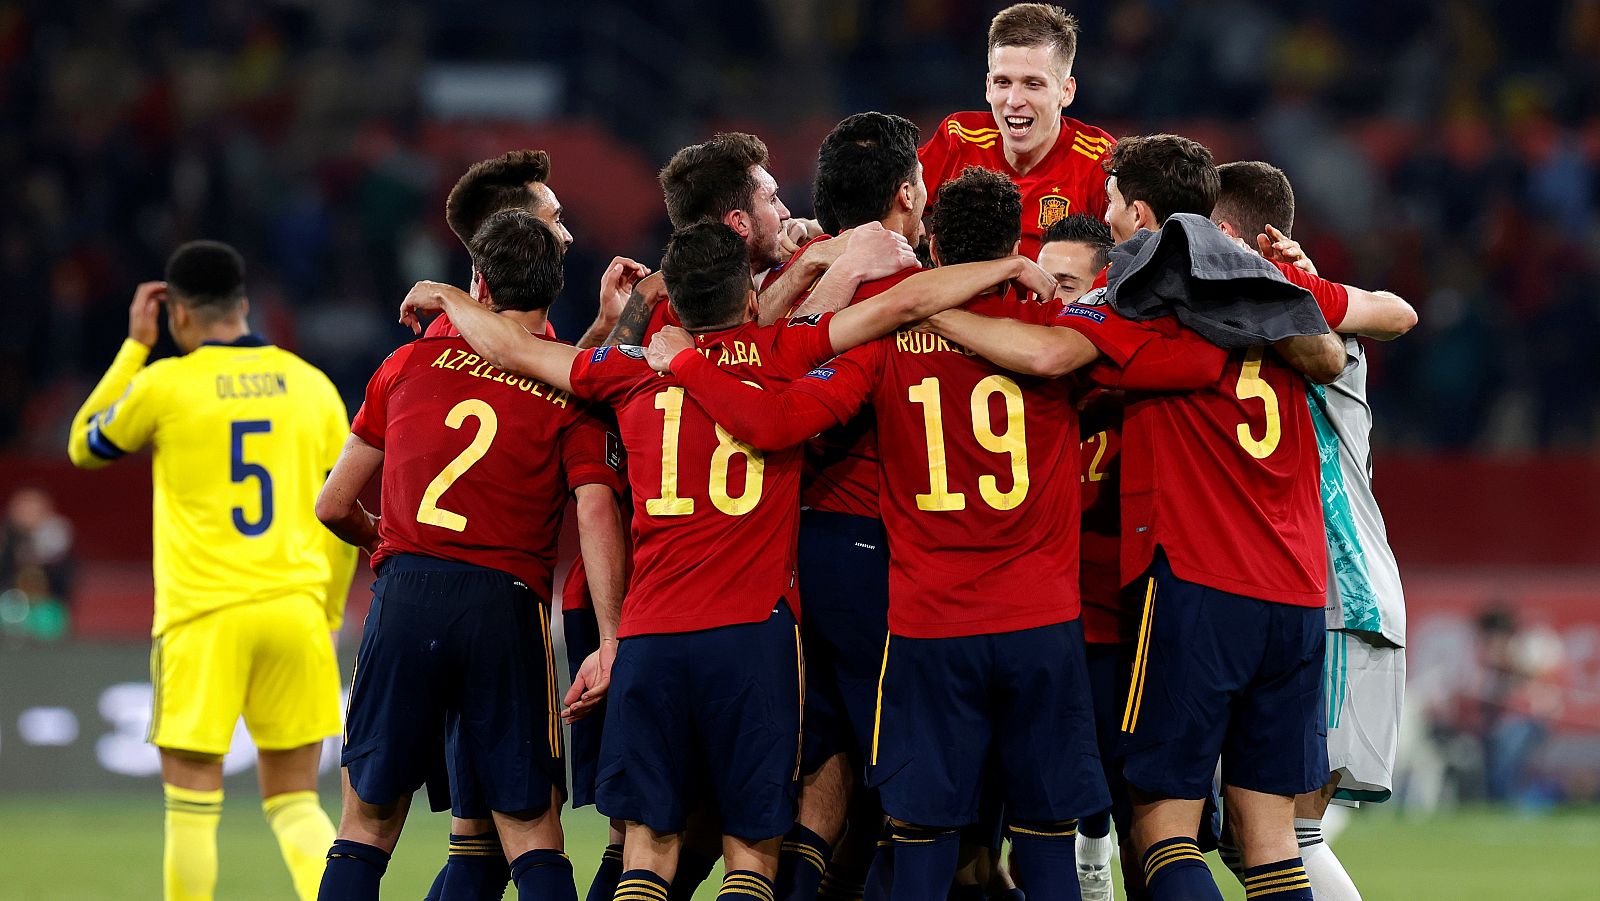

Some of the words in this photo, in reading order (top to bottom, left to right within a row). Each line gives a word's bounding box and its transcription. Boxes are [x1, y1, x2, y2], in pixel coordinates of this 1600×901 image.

[1068, 307, 1105, 322] RESPECT
[216, 372, 288, 399] OLSSON
[908, 374, 1030, 512] 19
[1236, 345, 1282, 459] 5
[230, 420, 274, 537] 5
[416, 399, 498, 532] 2
[646, 381, 764, 516] 18
[1080, 430, 1109, 483] 2
